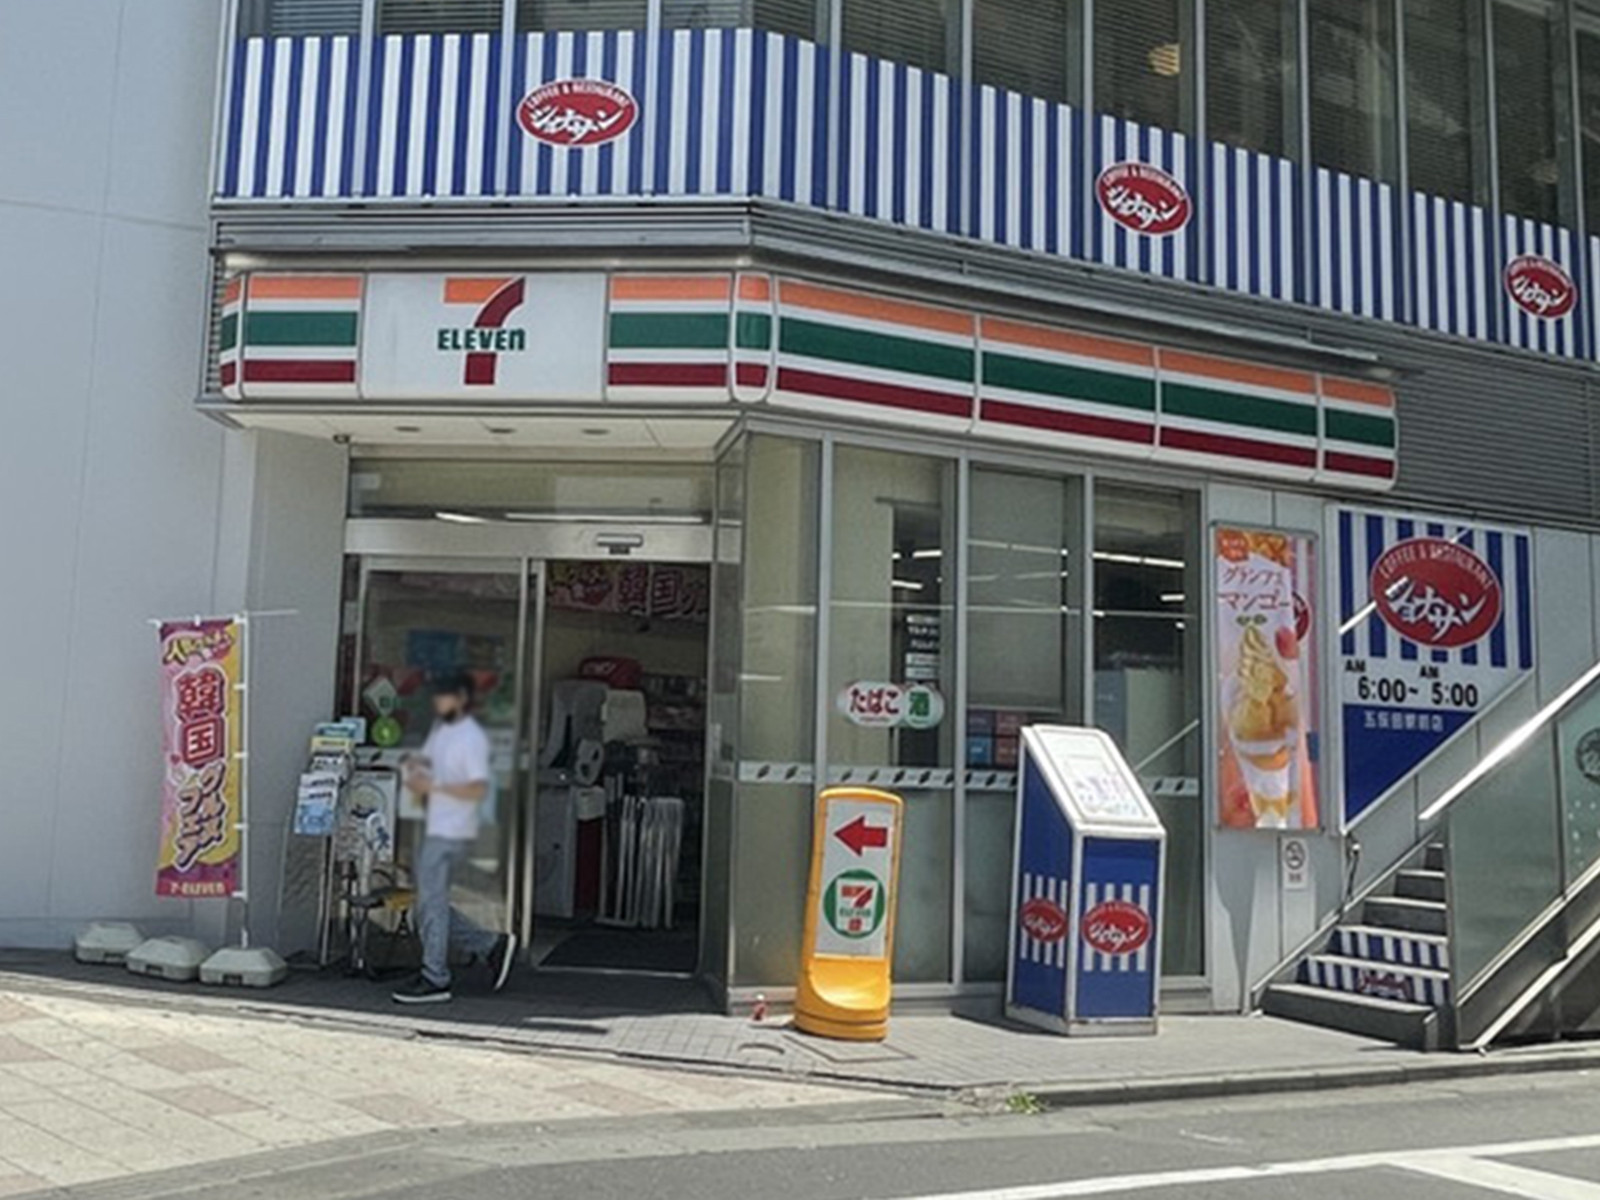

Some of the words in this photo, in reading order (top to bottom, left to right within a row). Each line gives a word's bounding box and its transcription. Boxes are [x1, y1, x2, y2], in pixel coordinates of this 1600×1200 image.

[443, 275, 527, 386] 7
[1345, 659, 1367, 673] AM
[1420, 666, 1440, 679] AM
[849, 687, 900, 715] たばこ
[1431, 680, 1479, 707] 5:00
